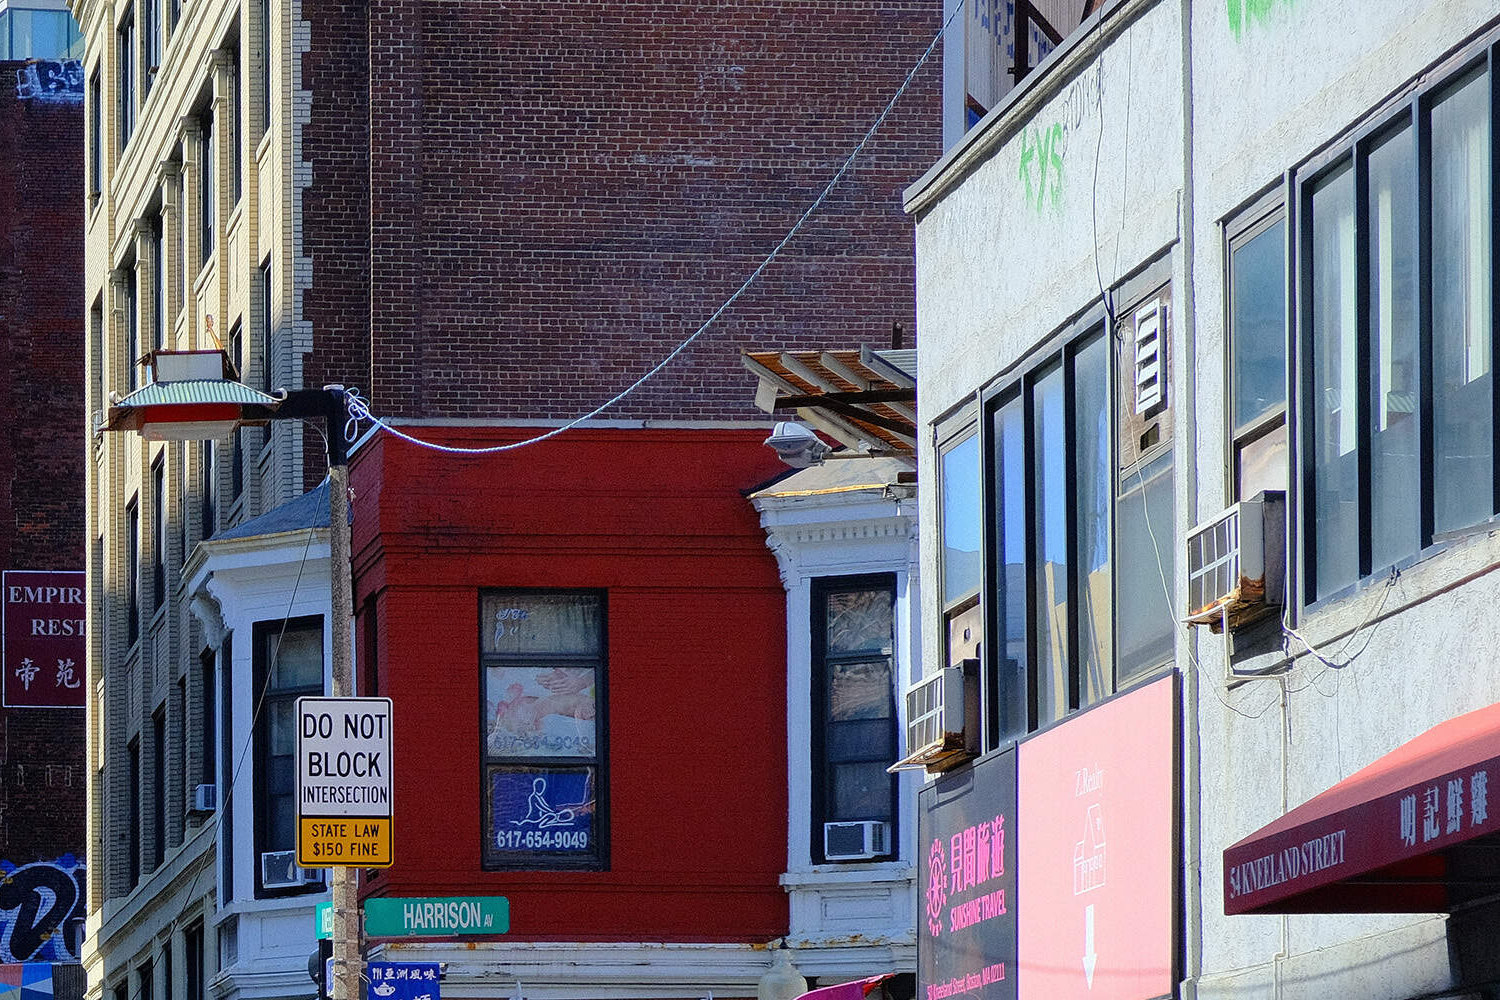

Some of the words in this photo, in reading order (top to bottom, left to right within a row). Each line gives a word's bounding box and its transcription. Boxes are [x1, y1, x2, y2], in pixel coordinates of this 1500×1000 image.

[8, 586, 86, 604] EMPIR
[31, 619, 86, 636] REST
[15, 657, 80, 691] 帝苑
[303, 713, 333, 739] DO
[344, 713, 387, 739] NOT
[308, 751, 381, 777] BLOCK
[303, 786, 387, 803] INTERSECTION
[311, 824, 347, 838] STATE
[355, 824, 380, 838] LAW
[497, 830, 588, 849] 617-654-9049
[313, 842, 343, 856] $150
[350, 842, 379, 856] FINE
[1230, 866, 1240, 899] 54
[1241, 847, 1300, 894] KNEELAND
[1301, 829, 1347, 875] STREET
[404, 901, 481, 929] HARRISON
[484, 914, 493, 928] AV
[950, 896, 981, 932] SUNSHINE
[981, 889, 1007, 922] TRAVEL
[384, 968, 436, 981] 亞洲風味
